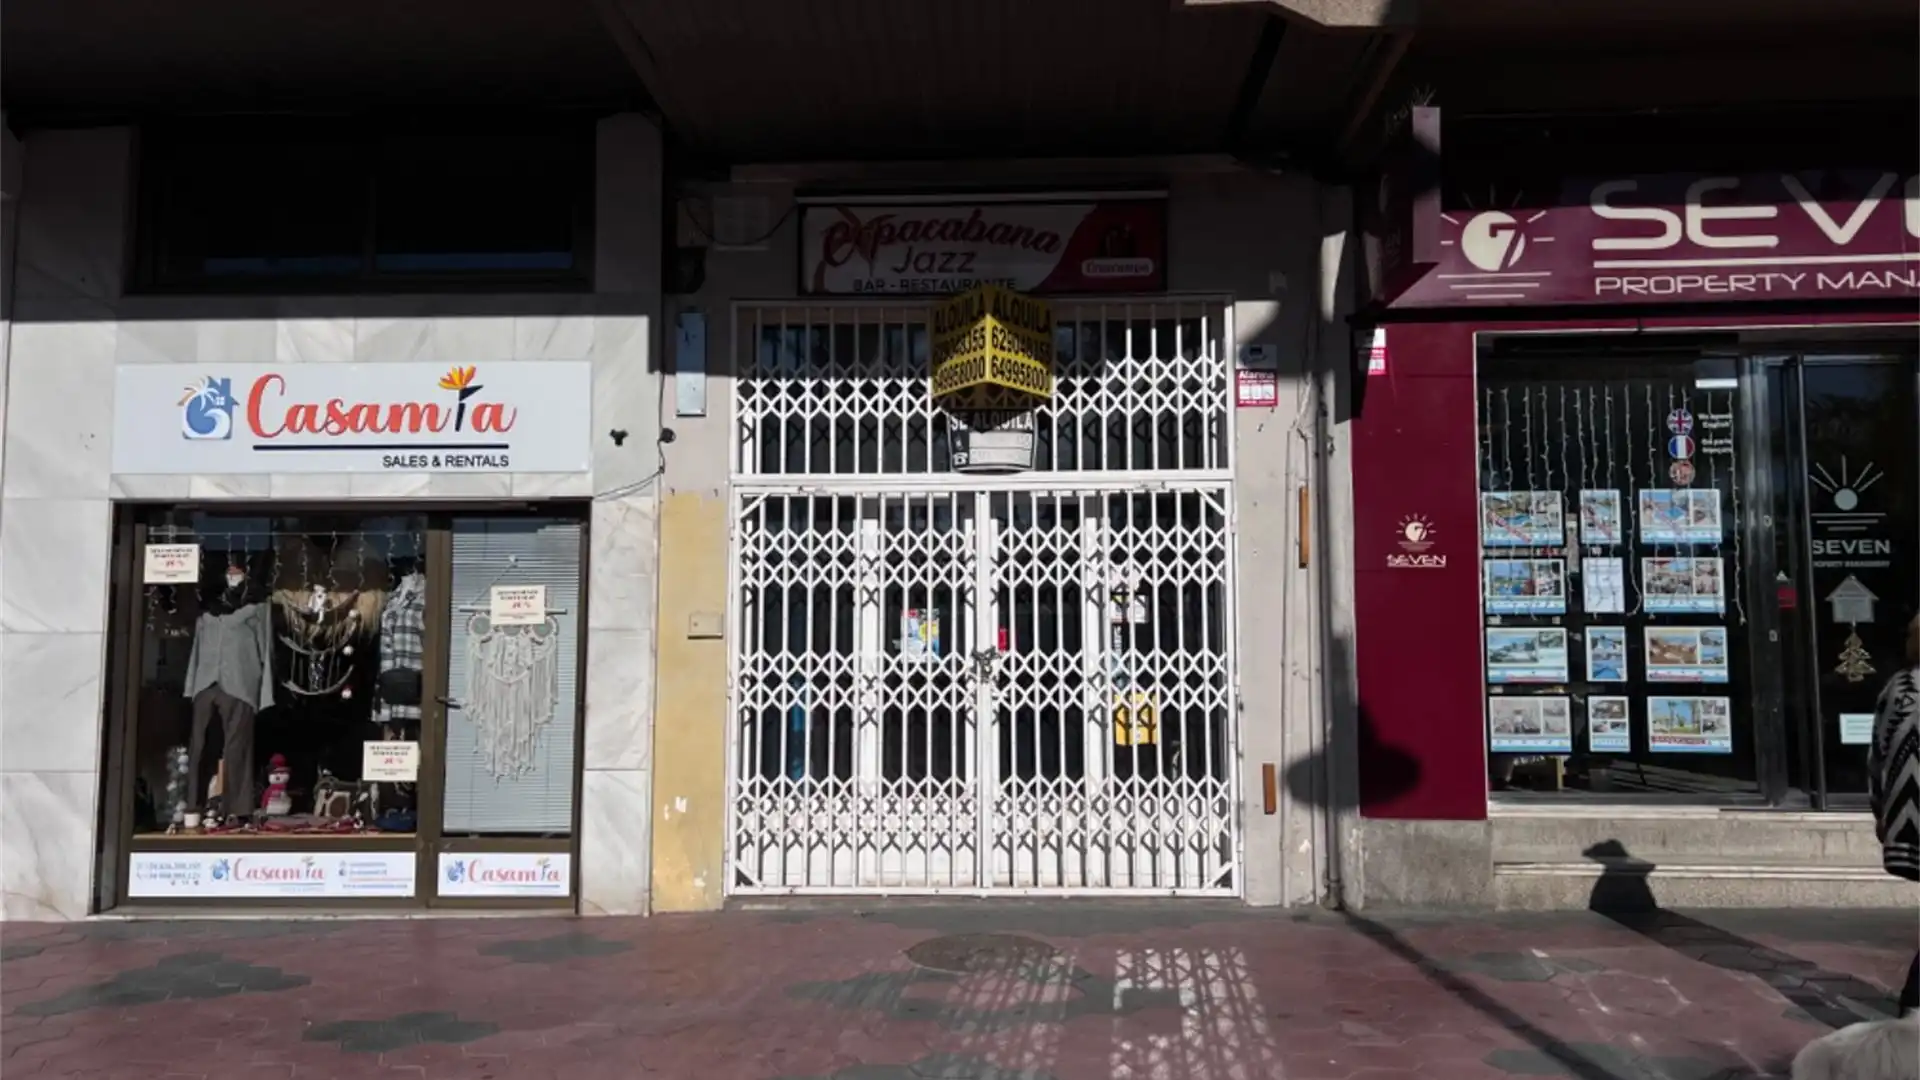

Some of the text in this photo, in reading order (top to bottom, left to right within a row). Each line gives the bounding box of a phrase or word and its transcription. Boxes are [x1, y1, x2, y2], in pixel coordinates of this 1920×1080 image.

[1590, 171, 1919, 251] SEV
[891, 246, 974, 274] Jazz
[1595, 269, 1919, 296] PROPERTY MAN
[247, 366, 517, 438] Casamia
[382, 455, 510, 468] SALES & RENTALS
[1387, 554, 1447, 567] SEVEN
[1812, 539, 1891, 555] SEVEN
